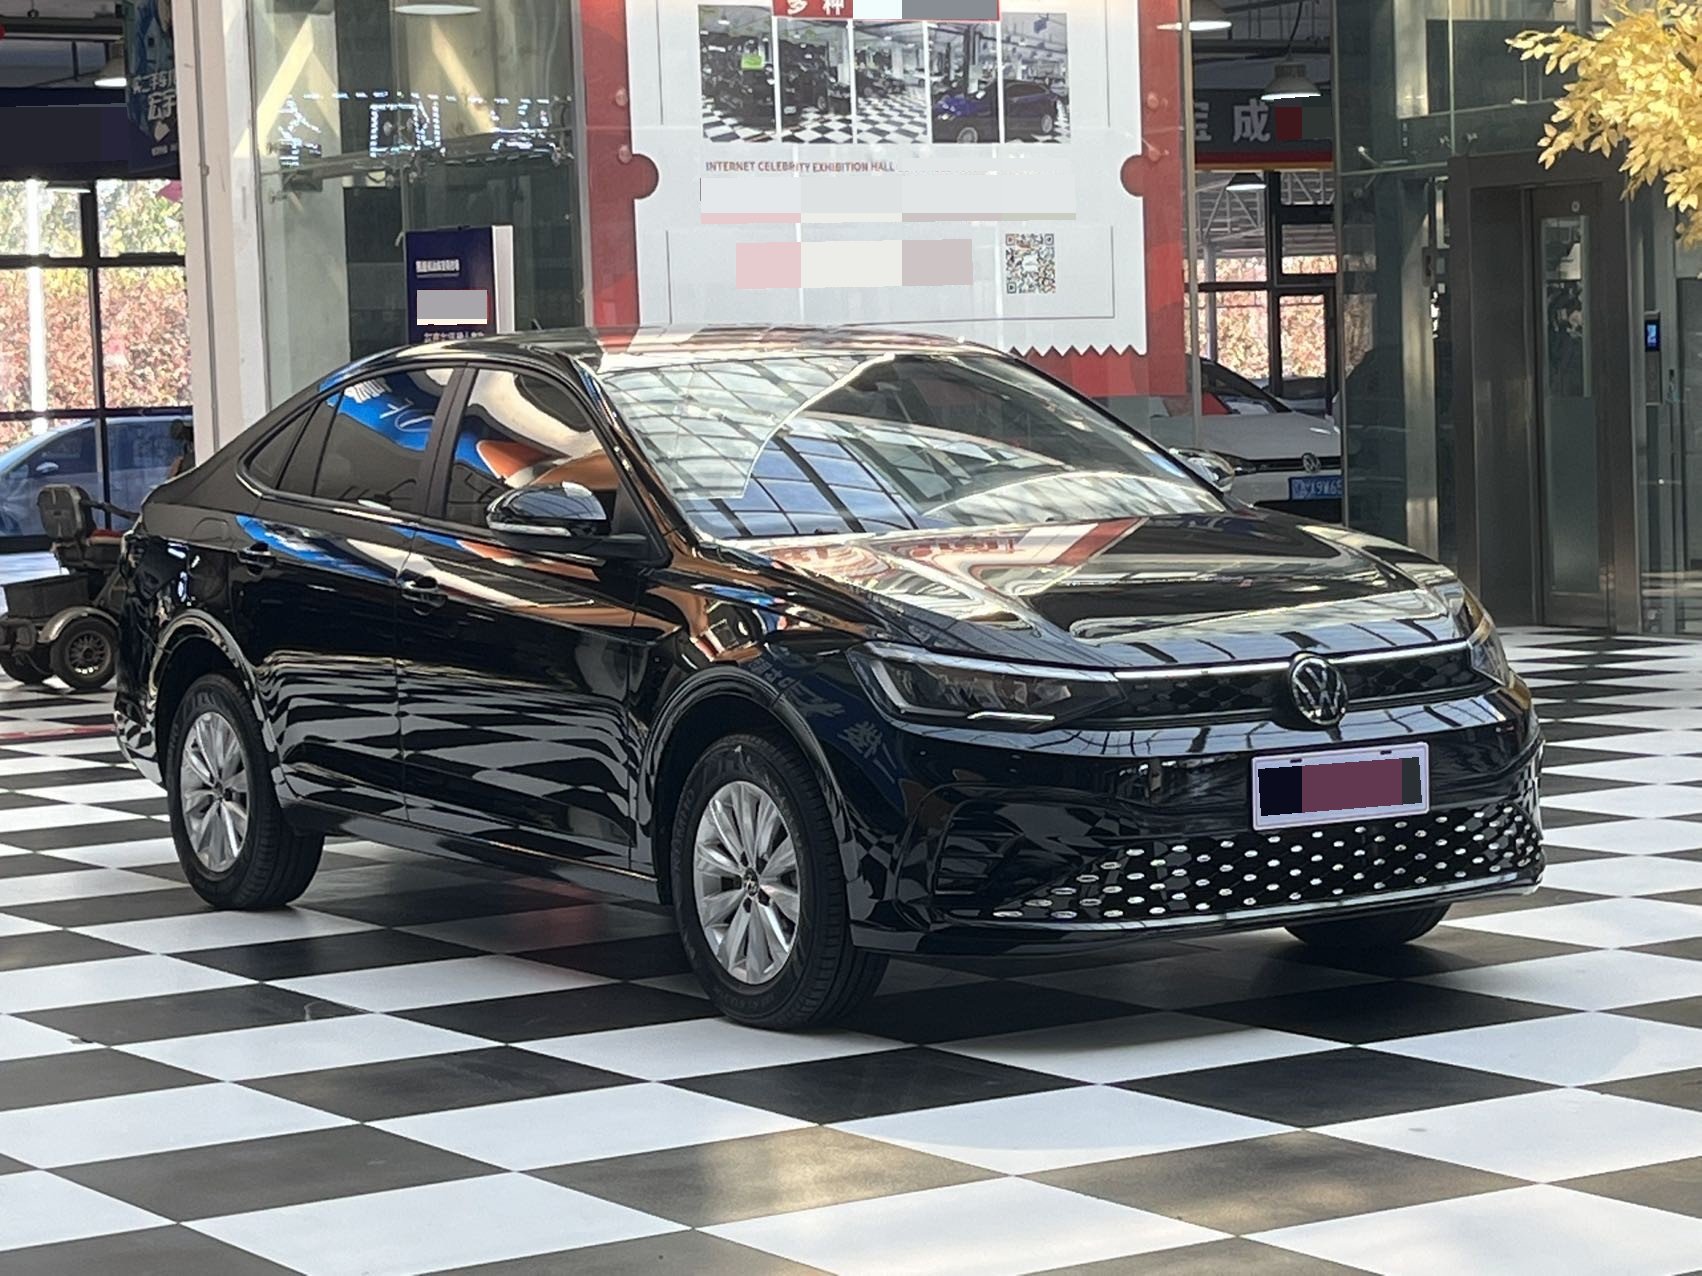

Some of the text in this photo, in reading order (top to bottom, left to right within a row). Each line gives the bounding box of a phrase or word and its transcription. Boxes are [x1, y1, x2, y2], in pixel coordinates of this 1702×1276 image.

[705, 161, 895, 173] INTERNET CELEBRITY EXHIBITION HALL
